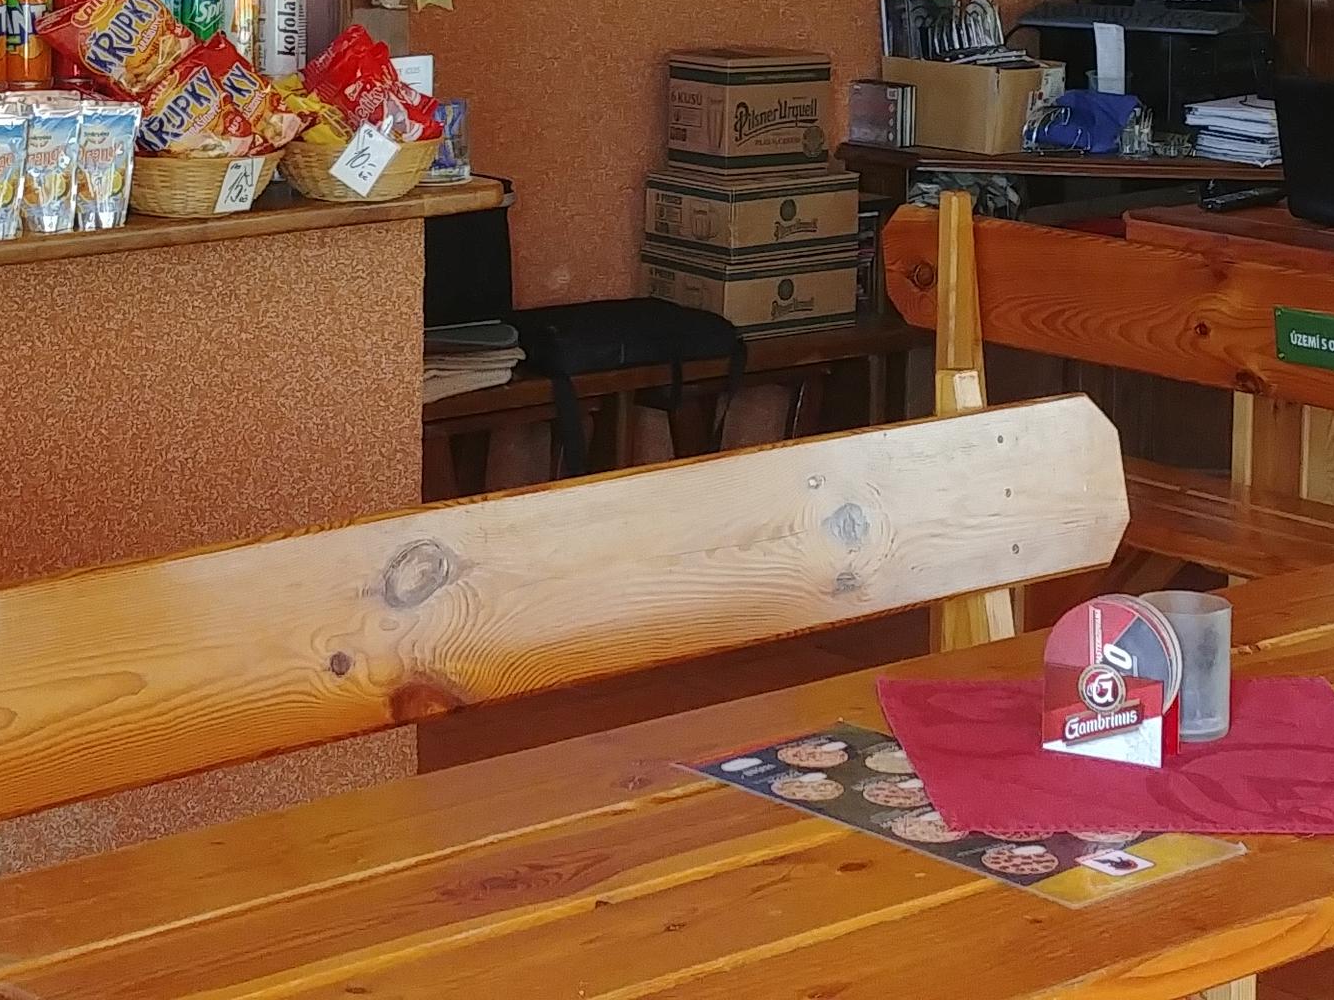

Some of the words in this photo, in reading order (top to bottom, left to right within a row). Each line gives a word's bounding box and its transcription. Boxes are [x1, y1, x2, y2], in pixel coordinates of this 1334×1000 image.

[277, 0, 297, 57] kofola
[137, 66, 219, 150] KŘUPKY
[733, 100, 778, 143] Pilsner
[778, 97, 818, 127] Urquell
[1290, 330, 1319, 350] ÚZEMÍ
[1321, 338, 1328, 351] S
[1064, 710, 1139, 740] Gambrinus
